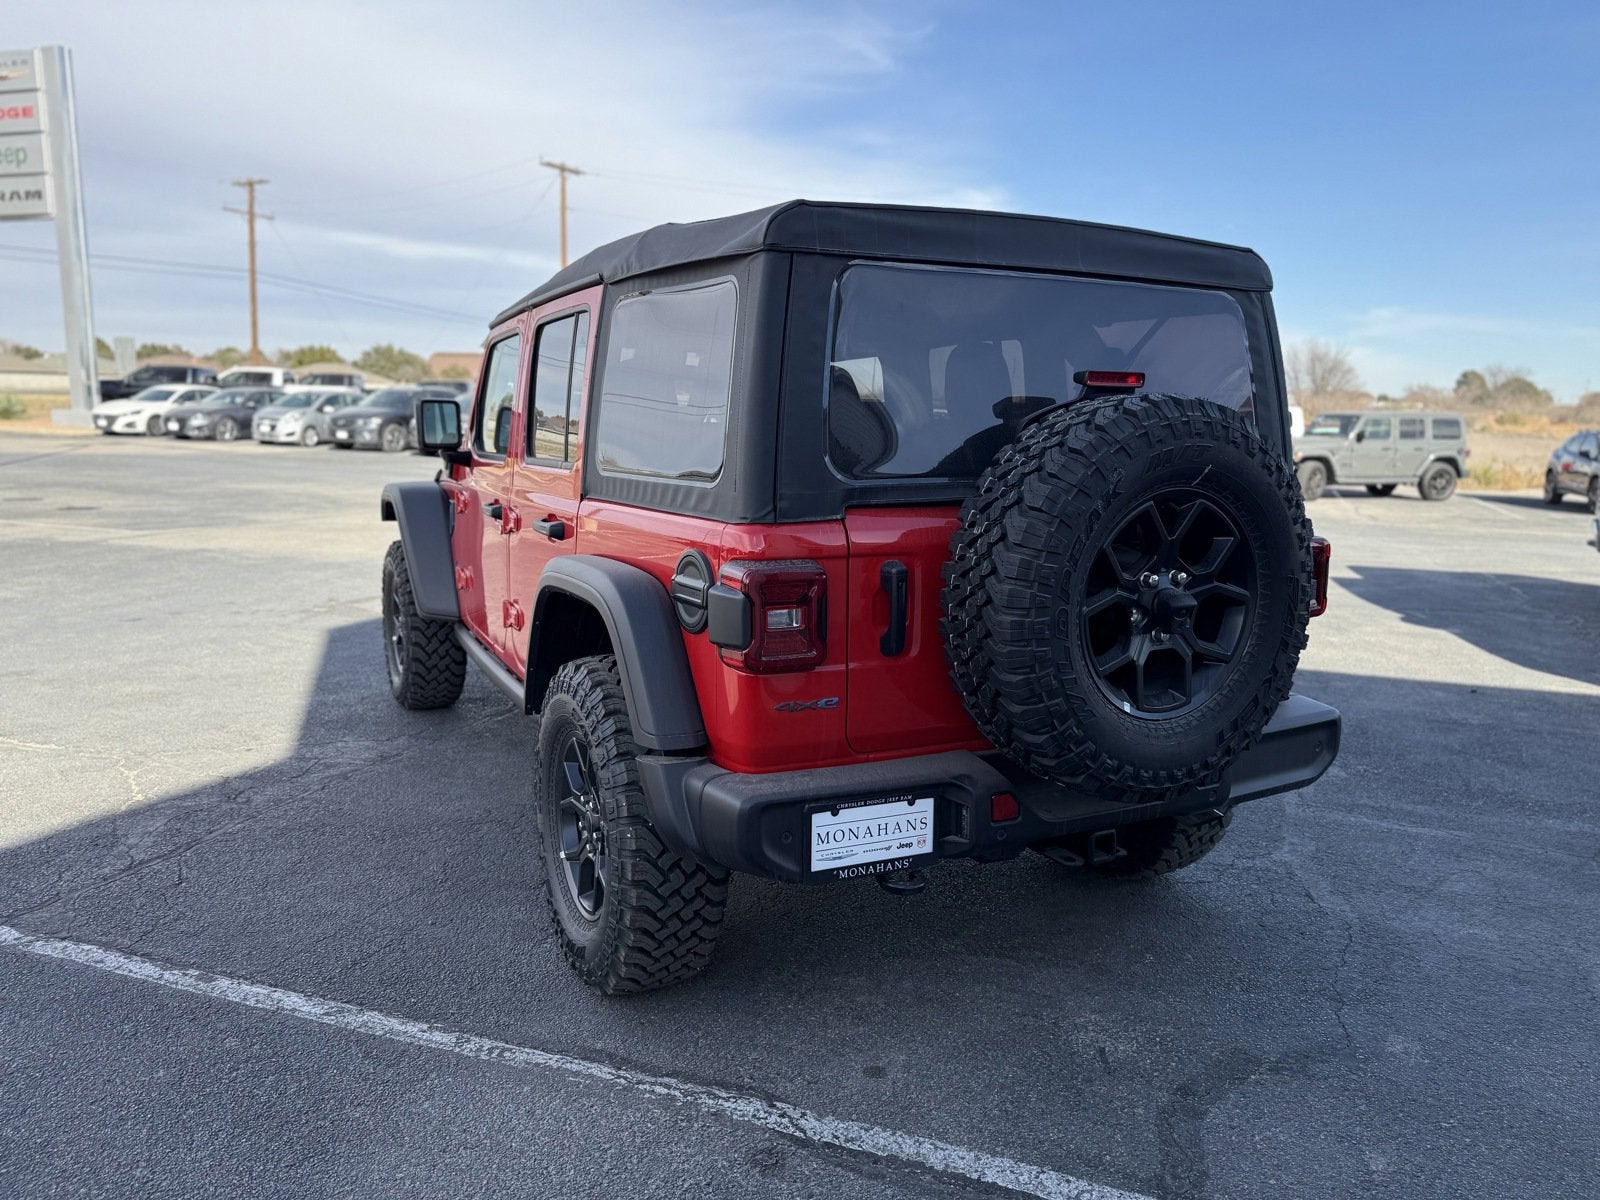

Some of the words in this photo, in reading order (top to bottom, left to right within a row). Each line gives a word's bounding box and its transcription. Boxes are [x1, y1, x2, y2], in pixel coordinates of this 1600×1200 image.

[0, 146, 28, 168] ep
[836, 801, 864, 809] CHRYSLER
[816, 817, 928, 846] MONAHANS
[896, 841, 913, 850] Jeep
